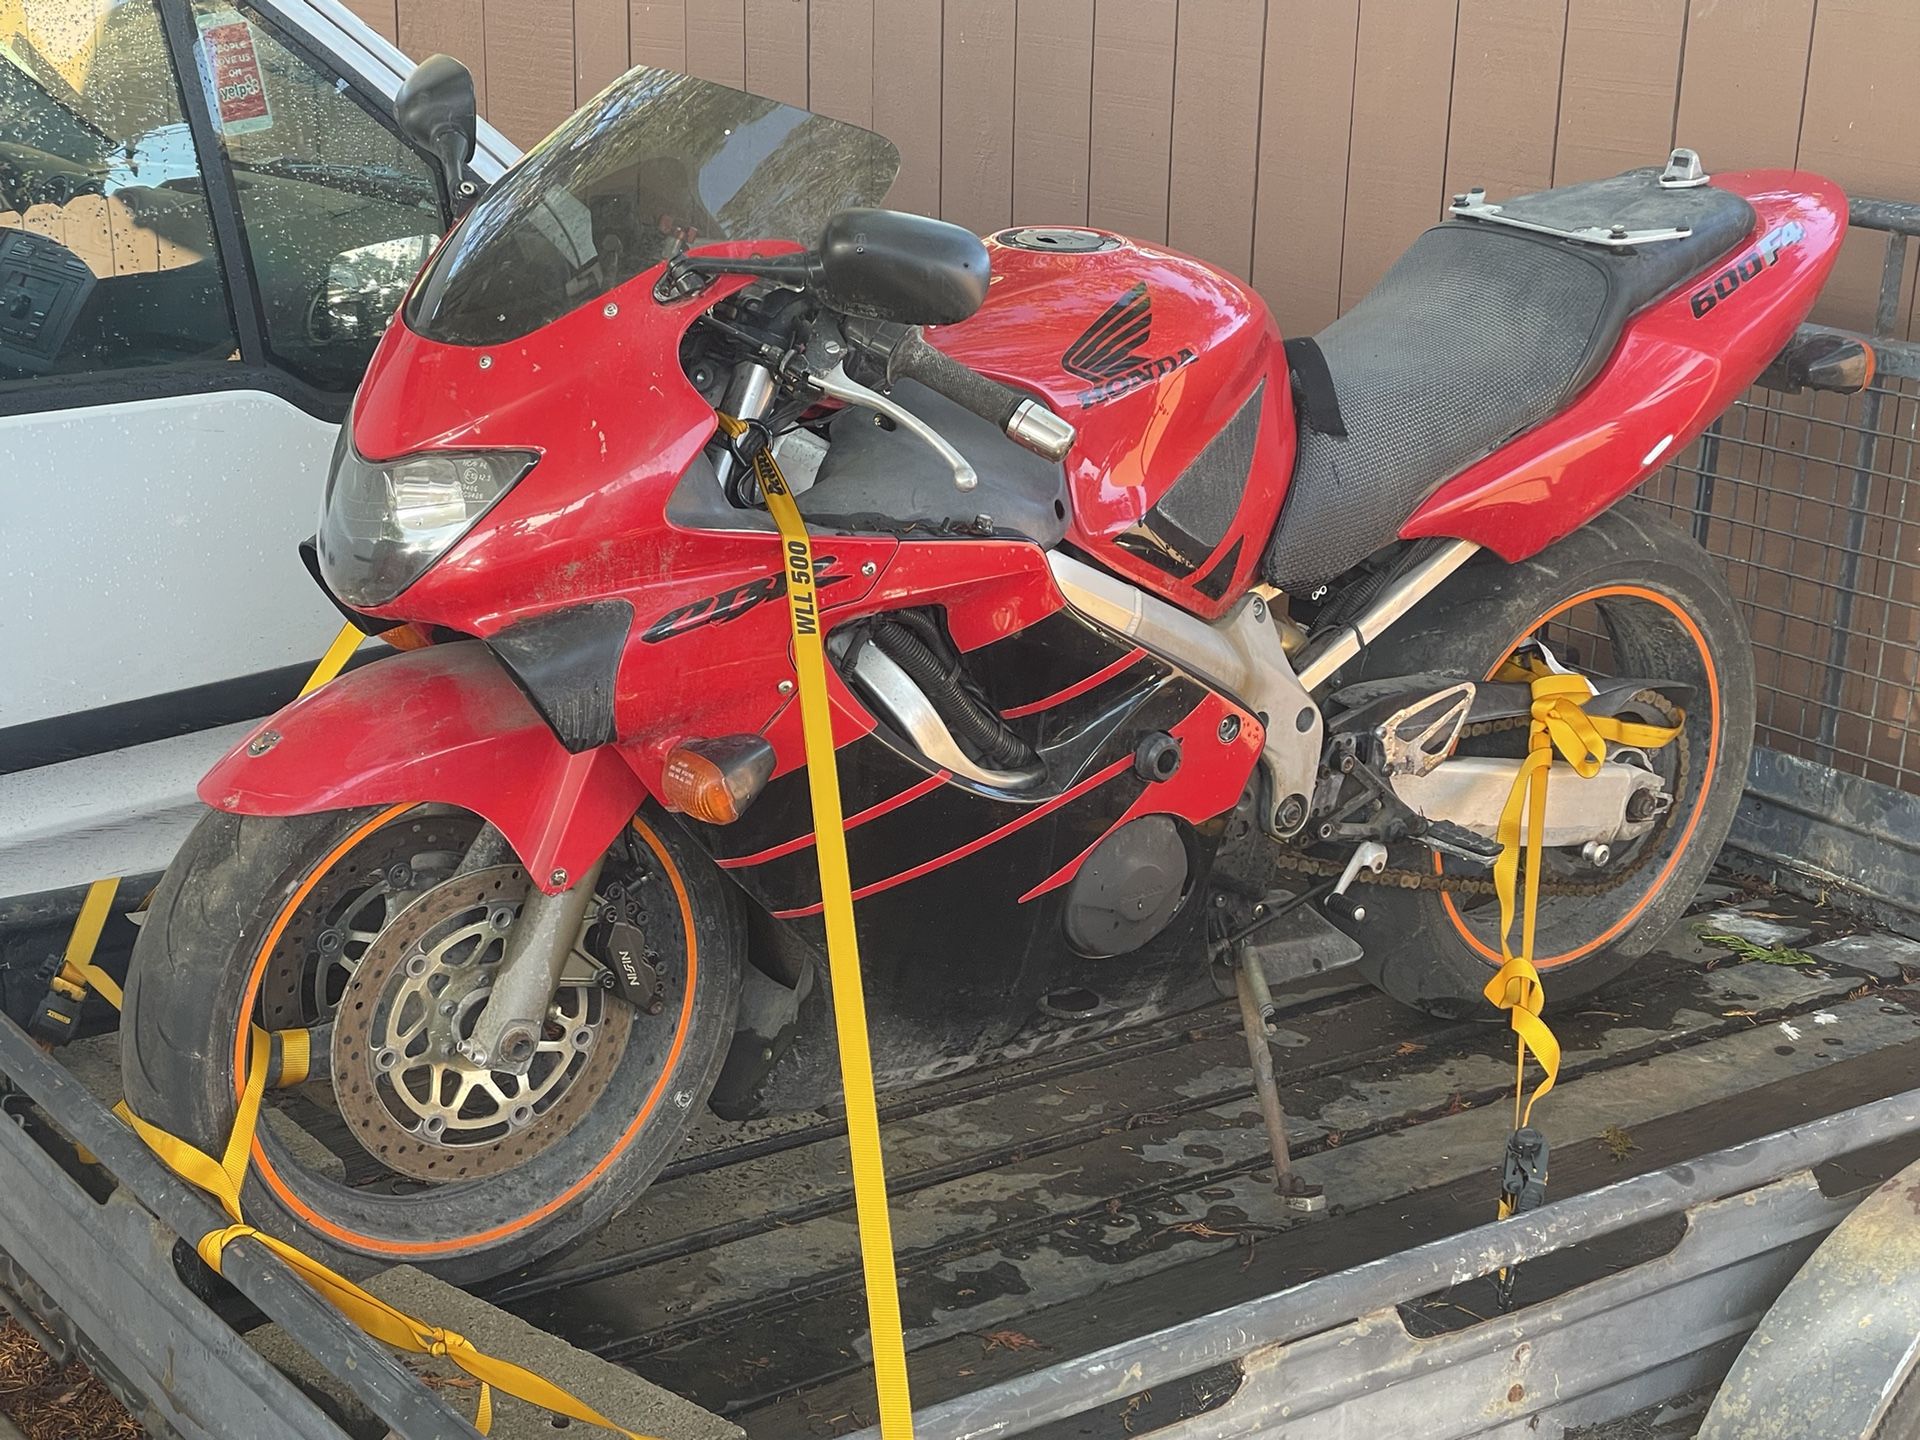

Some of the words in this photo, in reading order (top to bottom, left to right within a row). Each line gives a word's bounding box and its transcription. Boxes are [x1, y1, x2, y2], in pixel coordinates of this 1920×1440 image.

[219, 83, 247, 101] yelp
[1076, 347, 1200, 409] HONDA
[787, 540, 811, 585] 500
[794, 591, 817, 635] WLL
